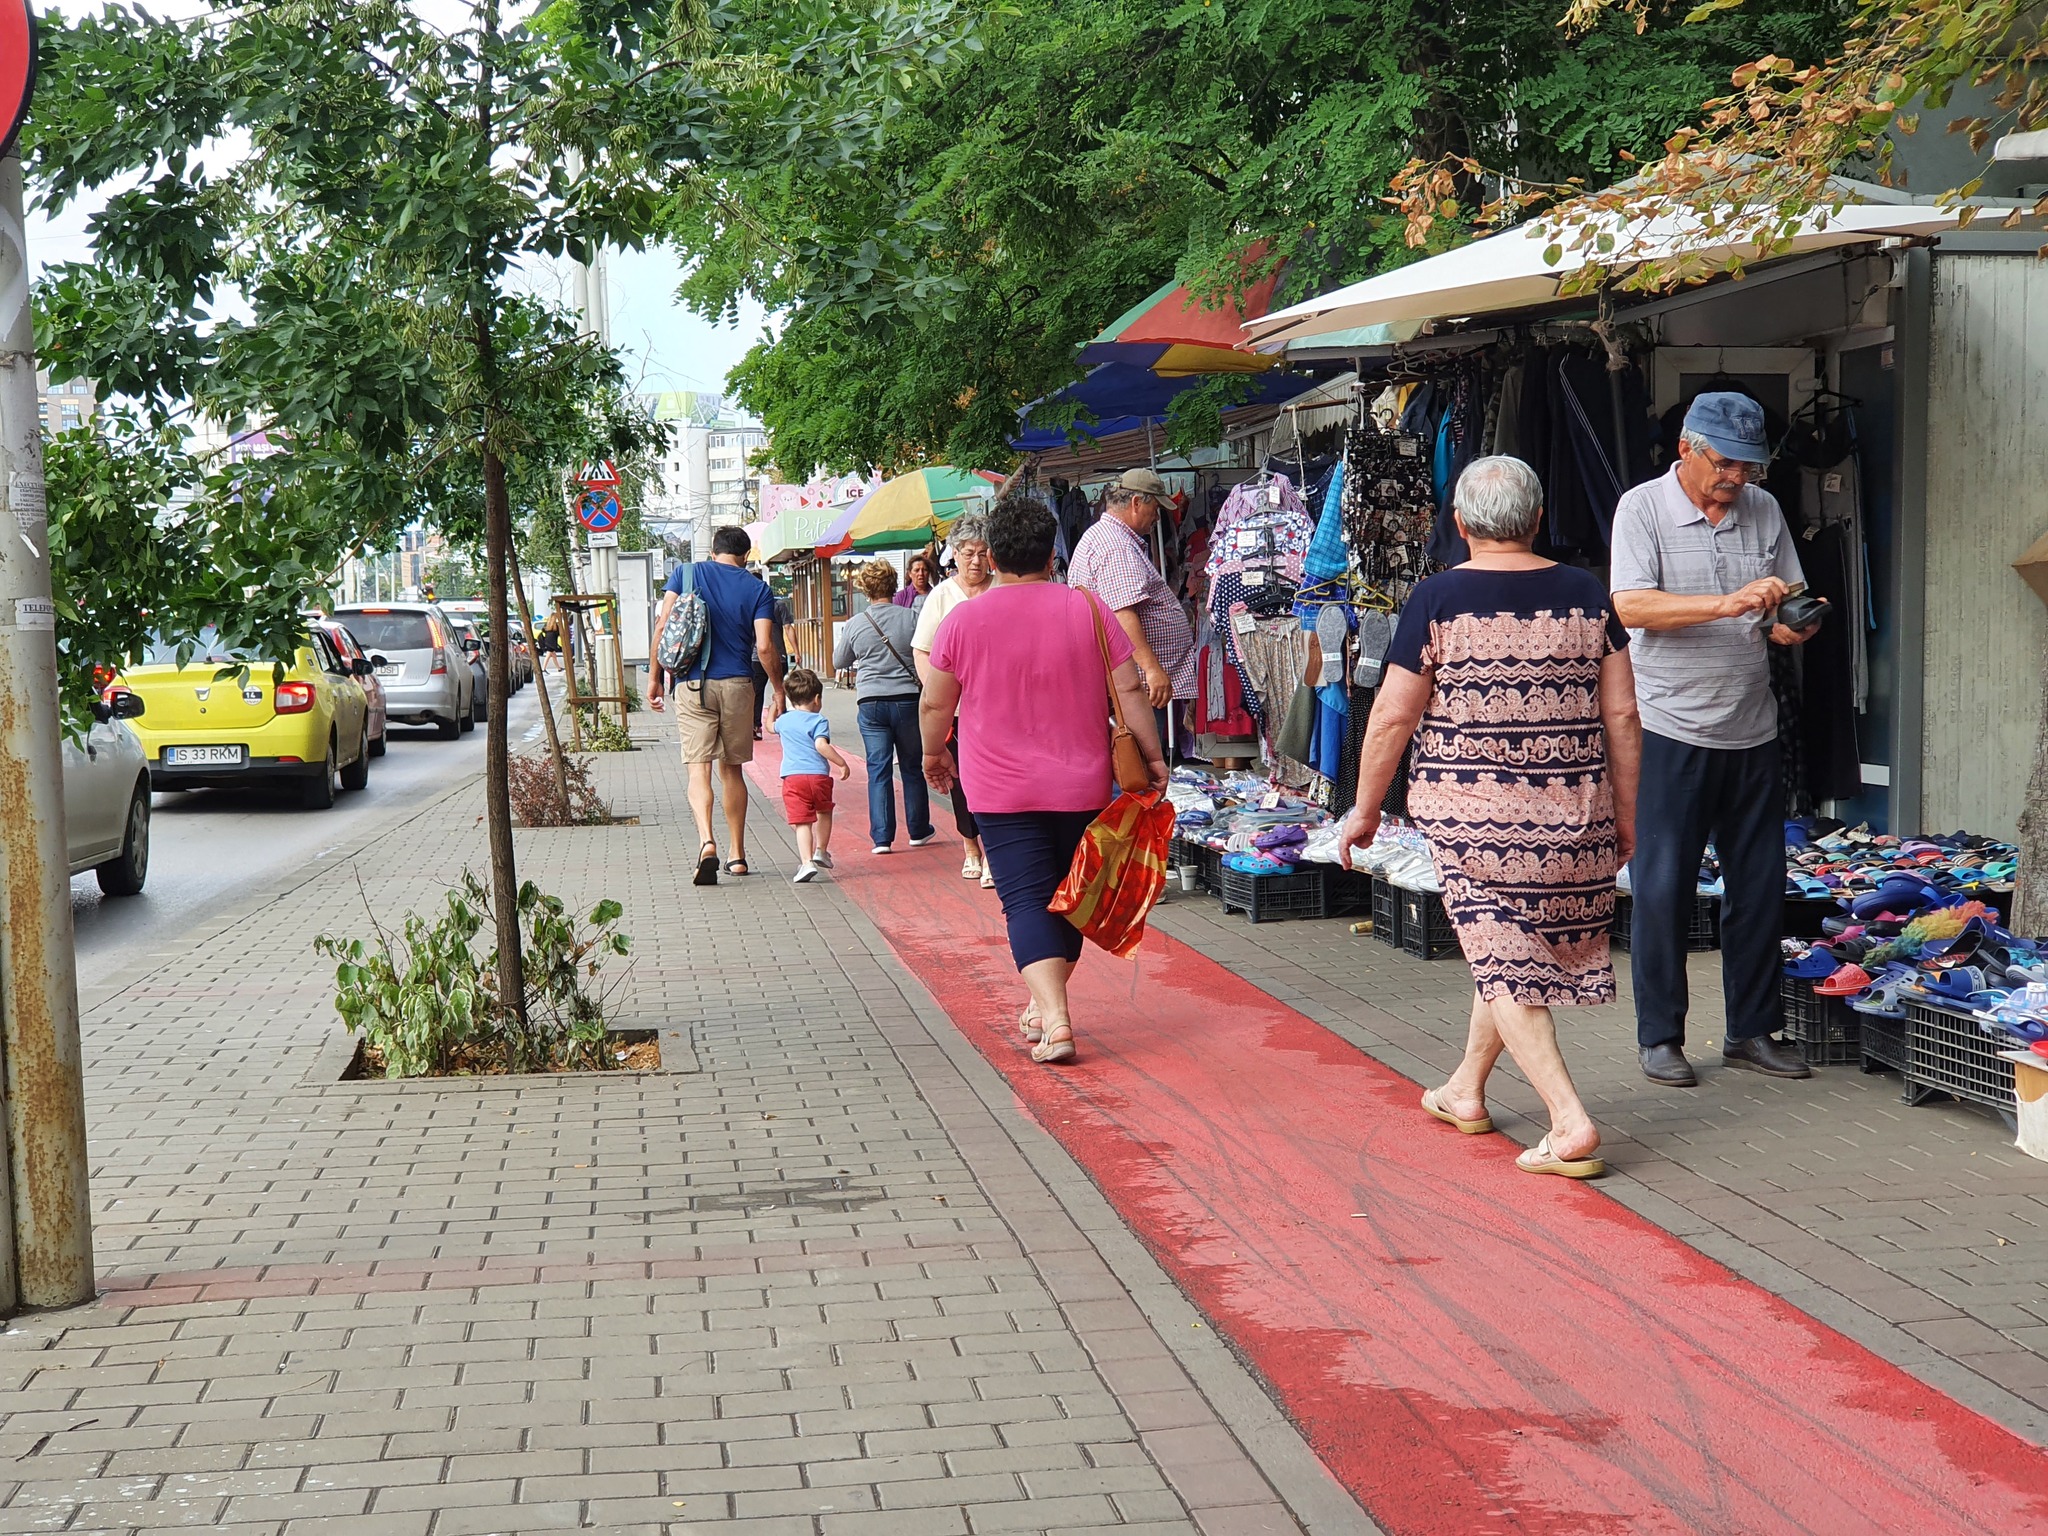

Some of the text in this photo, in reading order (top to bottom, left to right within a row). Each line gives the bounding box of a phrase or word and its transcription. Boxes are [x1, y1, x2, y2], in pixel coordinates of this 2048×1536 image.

[846, 489, 864, 498] ICE
[22, 603, 54, 612] TELEFO
[245, 691, 256, 699] 14
[176, 748, 238, 761] IS 33 RKM
